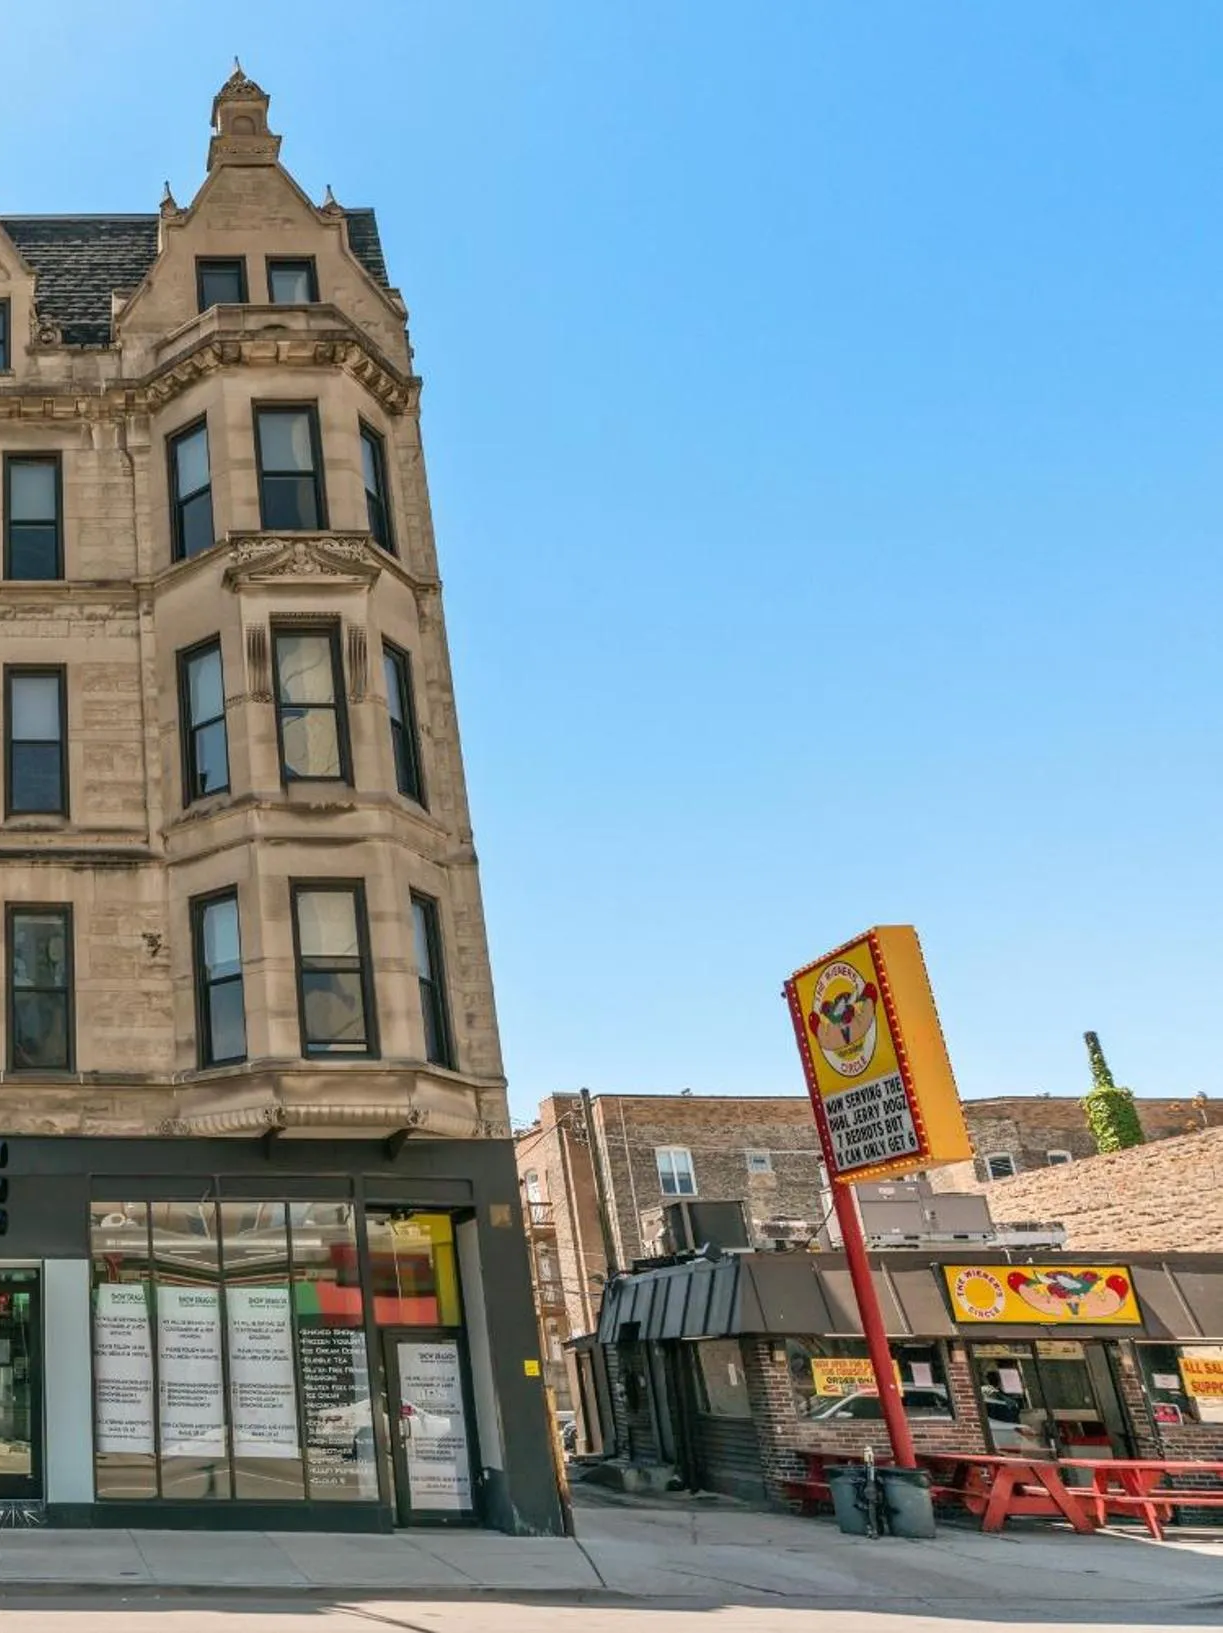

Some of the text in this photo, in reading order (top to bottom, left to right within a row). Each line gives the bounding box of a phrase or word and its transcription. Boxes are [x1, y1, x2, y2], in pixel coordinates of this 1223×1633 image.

[840, 1055, 868, 1073] CIRCLE
[826, 1076, 903, 1115] NOW SERVING THE
[853, 1102, 880, 1126] JERRY
[882, 1094, 908, 1115] DOGZ
[845, 1120, 885, 1147] REDHOTS
[884, 1114, 905, 1135] BUT
[844, 1146, 863, 1164] CAN
[863, 1140, 887, 1160] ONLY
[888, 1134, 907, 1153] GET
[907, 1130, 916, 1147] 6
[957, 1277, 965, 1297] THE
[968, 1306, 1001, 1318] CIRCLE
[1182, 1359, 1203, 1374] ALL
